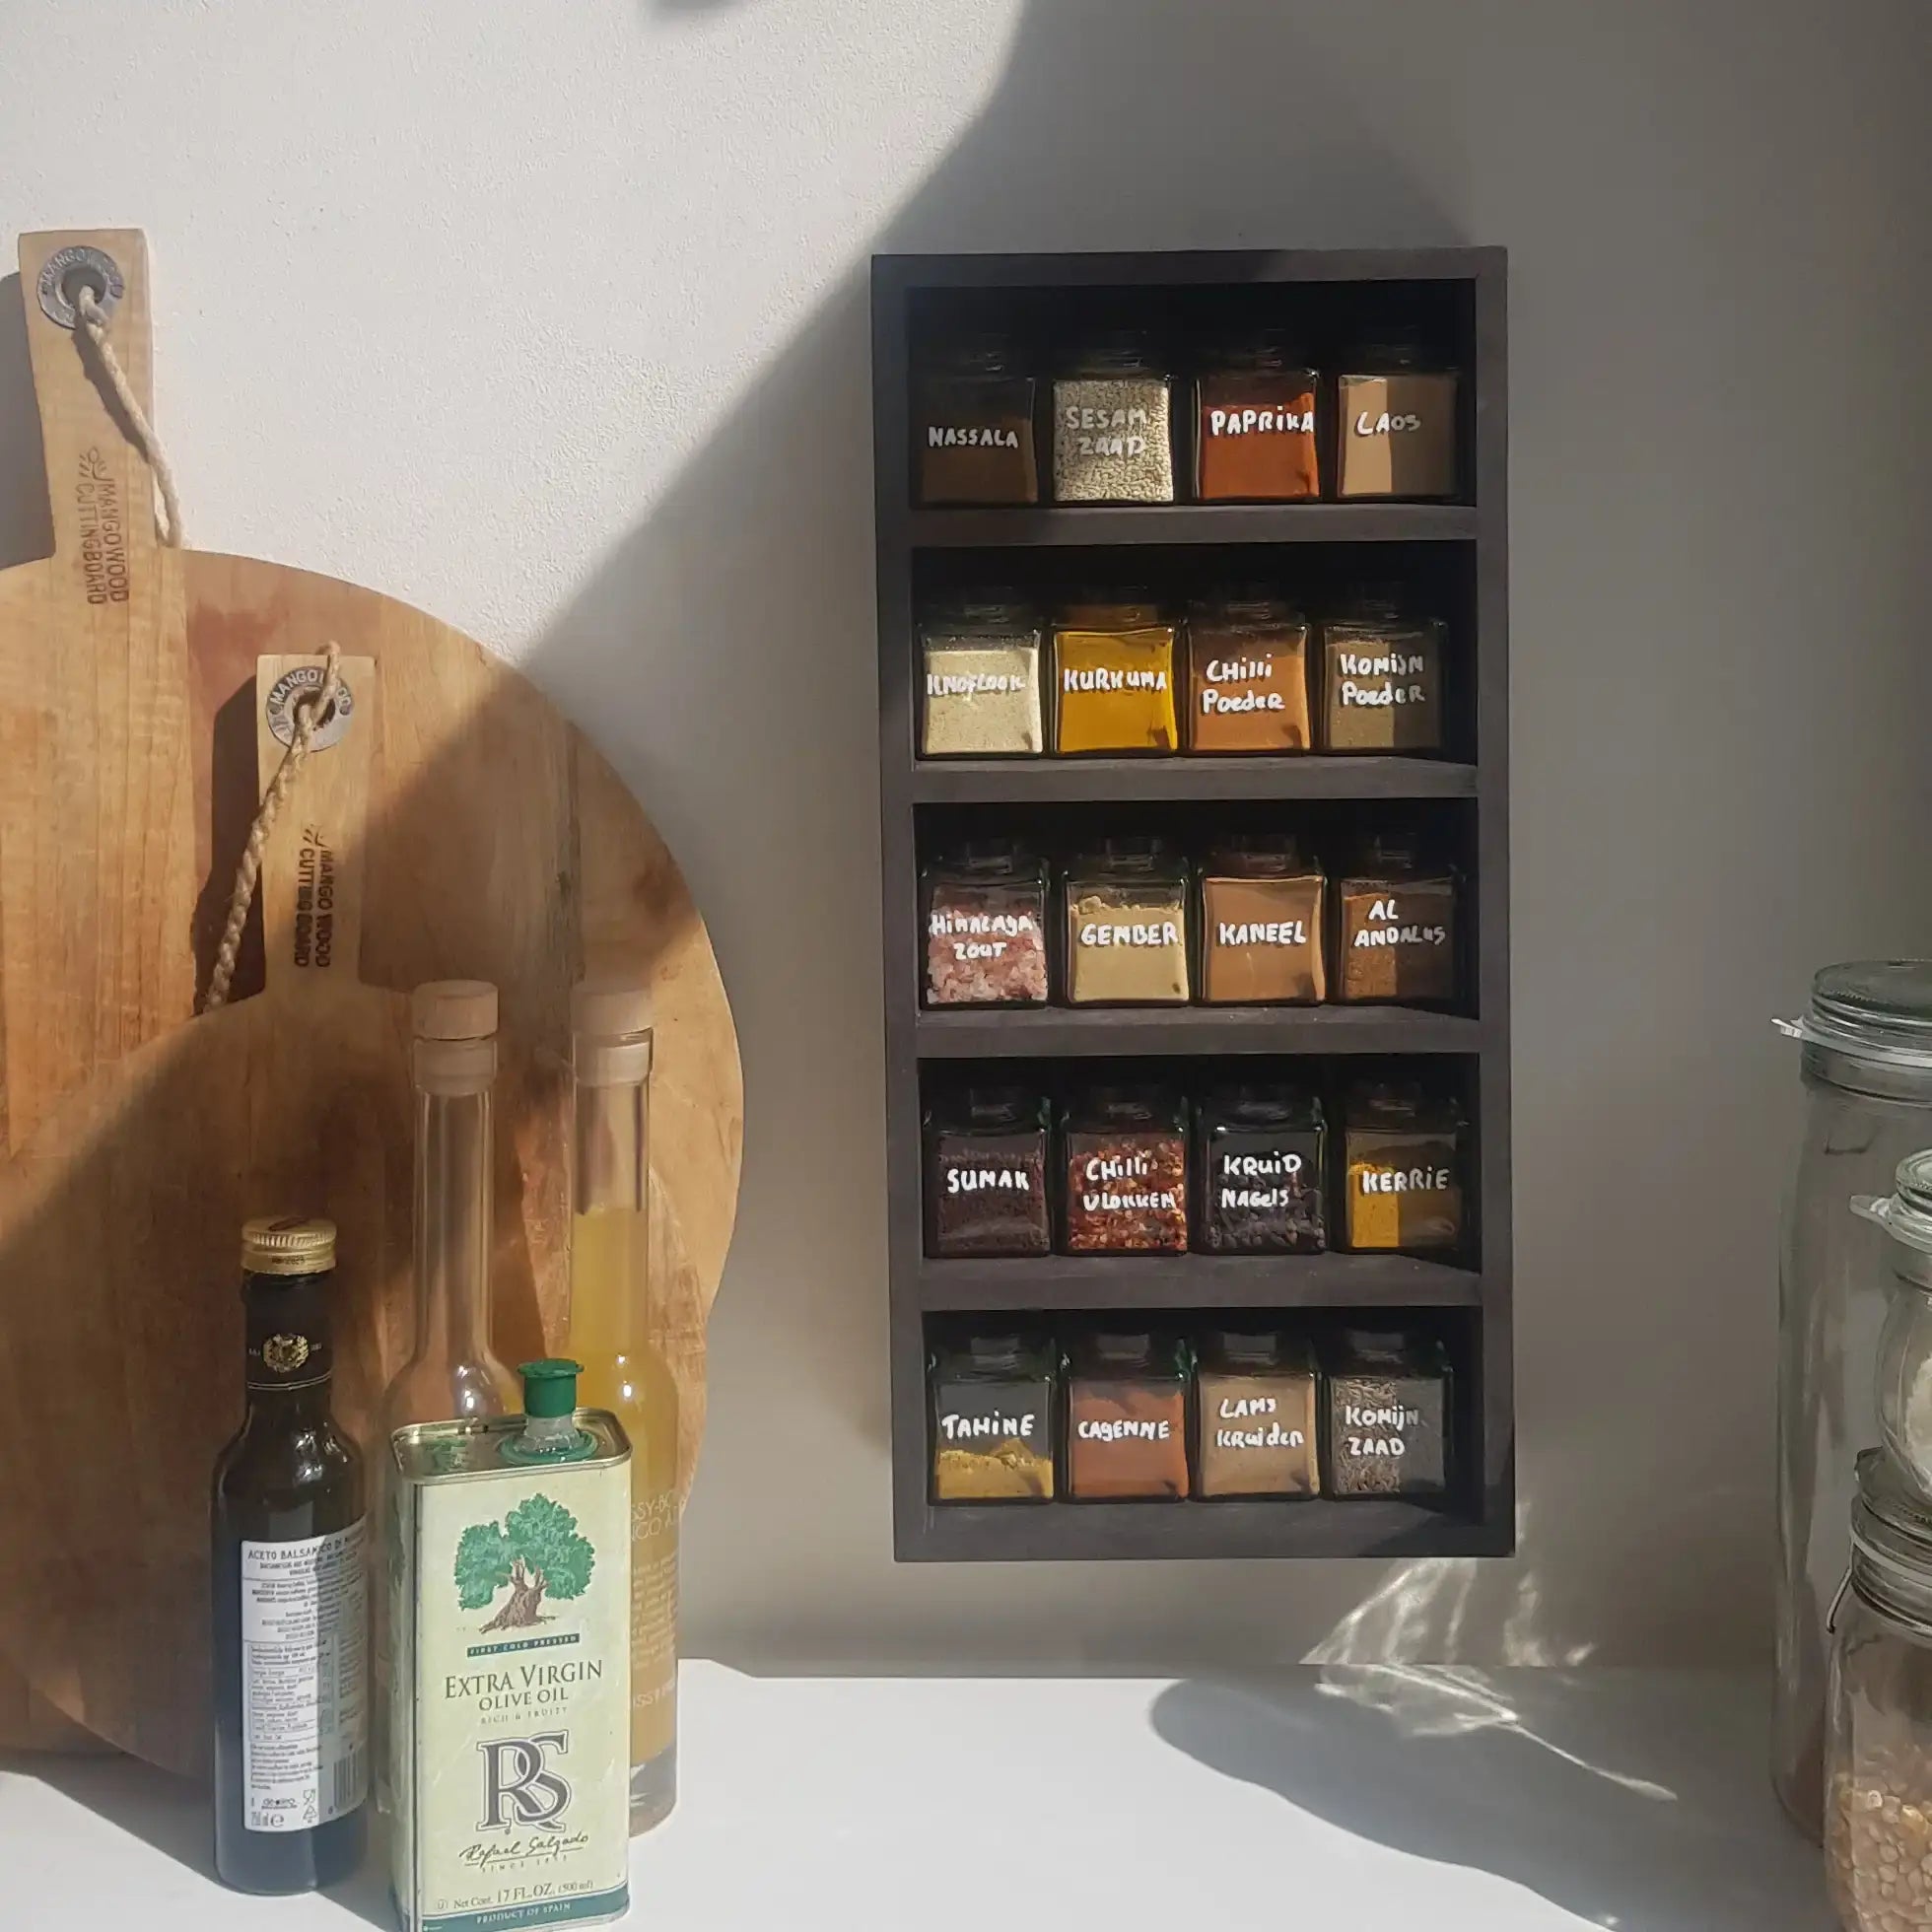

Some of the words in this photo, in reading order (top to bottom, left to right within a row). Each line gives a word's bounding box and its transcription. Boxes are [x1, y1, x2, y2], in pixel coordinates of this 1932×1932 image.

[1066, 406, 1147, 430] SESAM
[1357, 411, 1421, 435] LAOS
[269, 669, 318, 705] MANGO
[1368, 899, 1399, 921] AL
[1080, 921, 1179, 946] GEMBER
[1218, 920, 1307, 946] KANEEL
[947, 1168, 1030, 1194] SUMAK
[1083, 1191, 1177, 1212] VLOKKEN
[1347, 1436, 1406, 1456] ZAAD
[247, 1550, 277, 1560] ACETO
[478, 1690, 532, 1711] OLIVE
[536, 1687, 569, 1704] OIL
[458, 1840, 521, 1869] Rafael
[525, 1829, 588, 1857] Salgado
[453, 1898, 469, 1909] Net
[496, 1889, 511, 1903] 17
[476, 1908, 524, 1924] PRODUCT
[526, 1906, 540, 1917] OF
[543, 1901, 572, 1914] SPAIN
